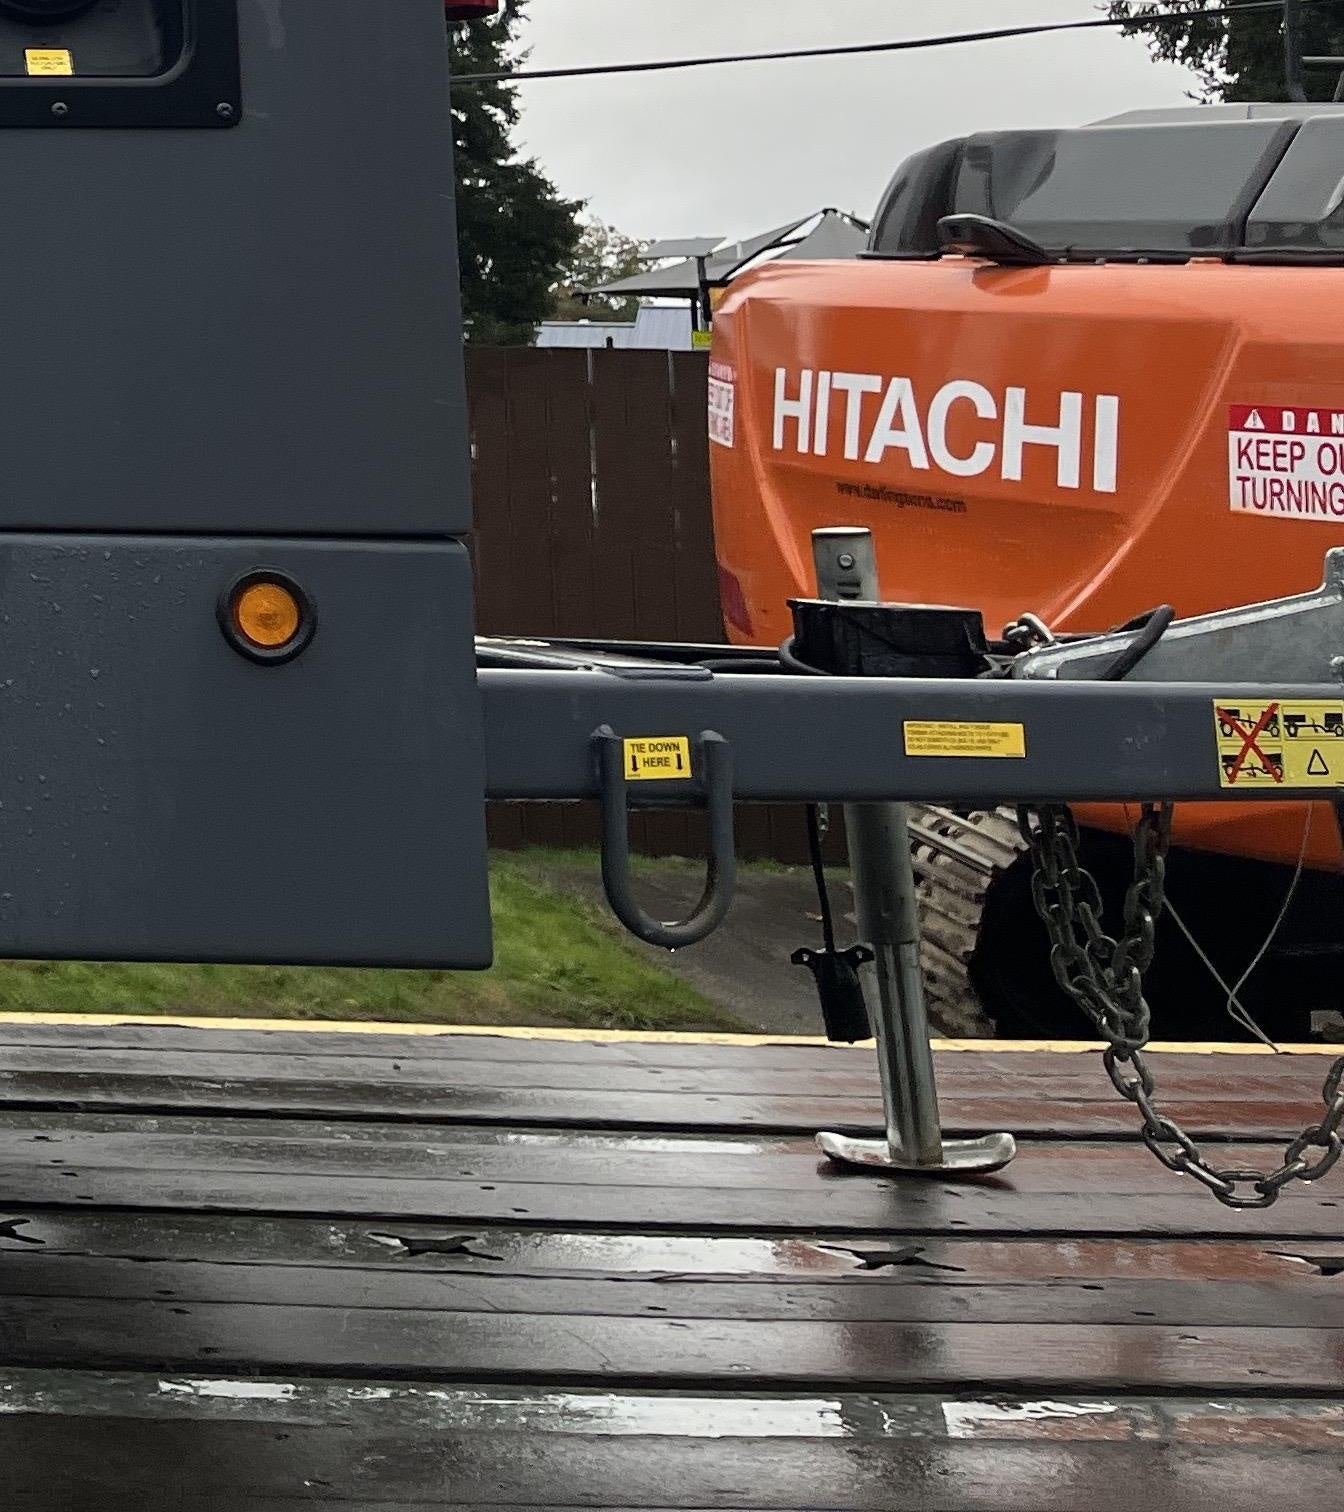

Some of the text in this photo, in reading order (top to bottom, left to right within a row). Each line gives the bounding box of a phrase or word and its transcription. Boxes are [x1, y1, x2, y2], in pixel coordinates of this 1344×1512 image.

[773, 366, 1120, 493] HITACHI
[1237, 437, 1344, 476] KEEP O
[630, 742, 680, 753] TIE DOWN
[643, 757, 671, 768] HERE
